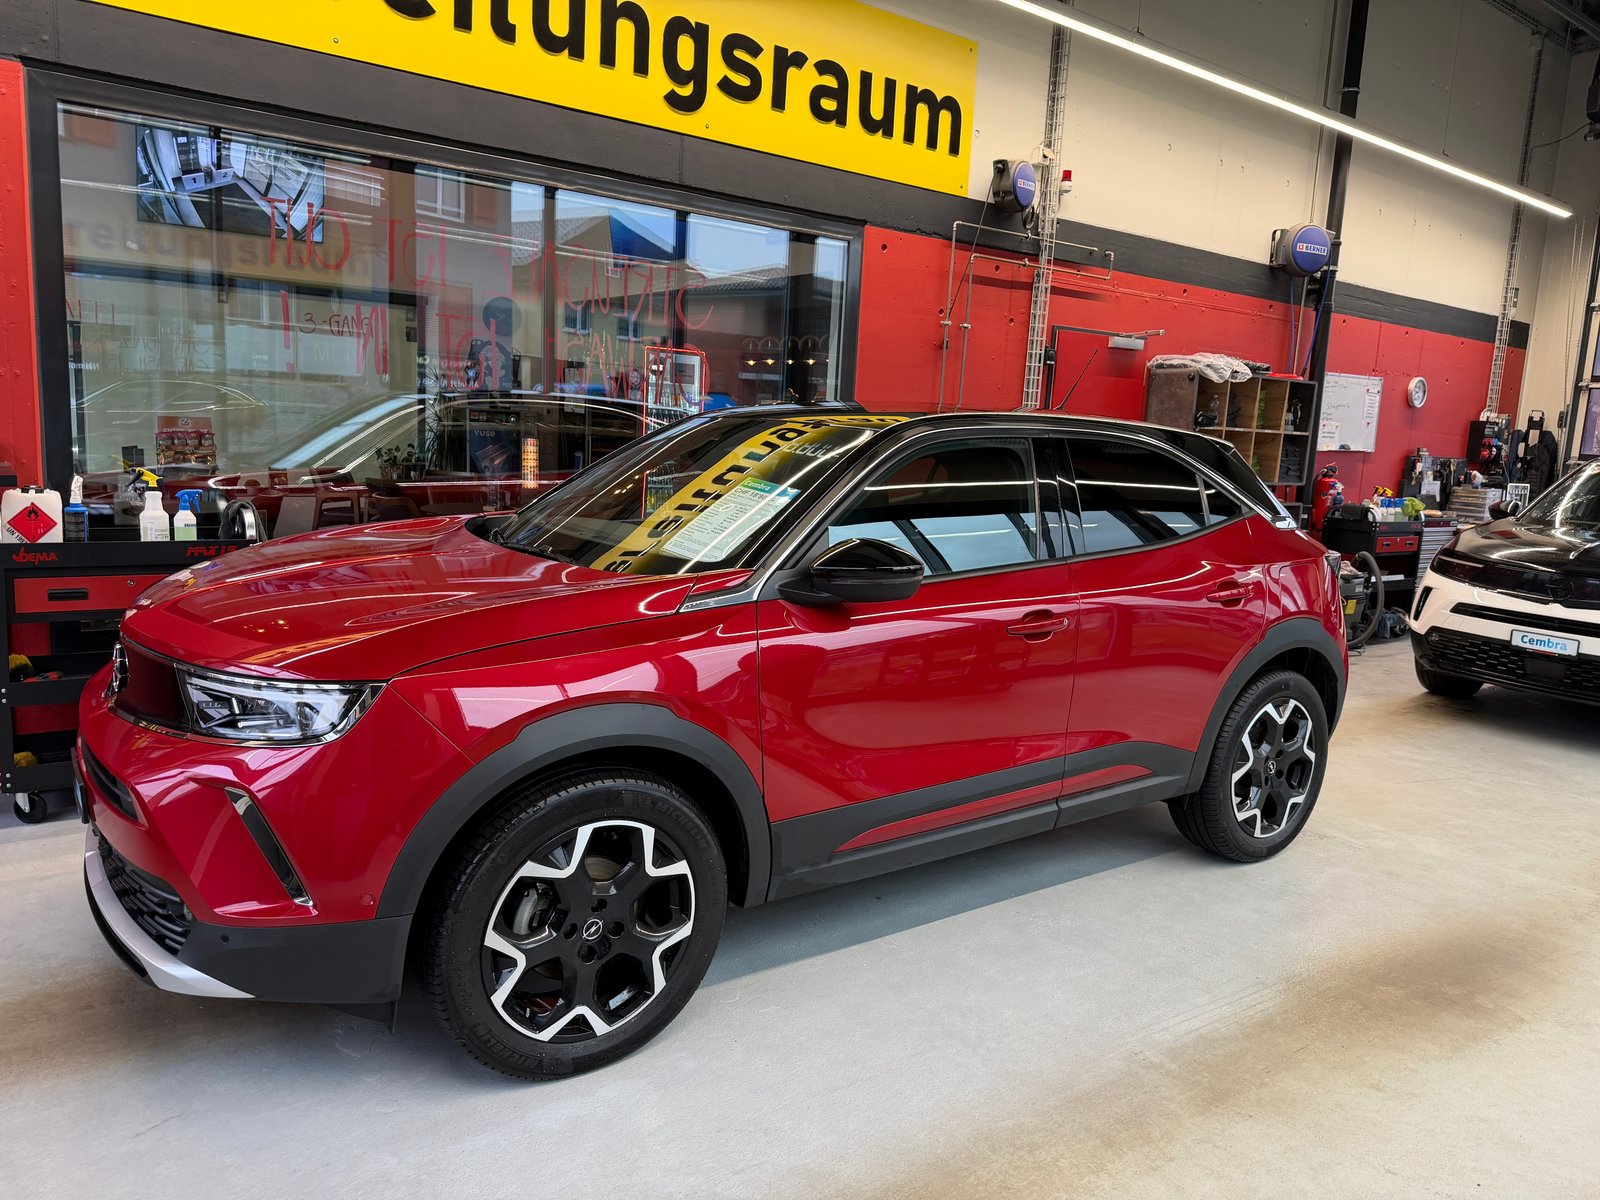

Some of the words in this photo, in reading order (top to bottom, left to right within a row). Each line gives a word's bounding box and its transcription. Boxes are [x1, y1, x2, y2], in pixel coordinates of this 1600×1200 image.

[381, 0, 961, 156] ungsraum
[1304, 244, 1327, 254] BERNER
[744, 480, 772, 491] Cembra
[6, 527, 16, 537] UN
[1521, 634, 1568, 651] Cembra
